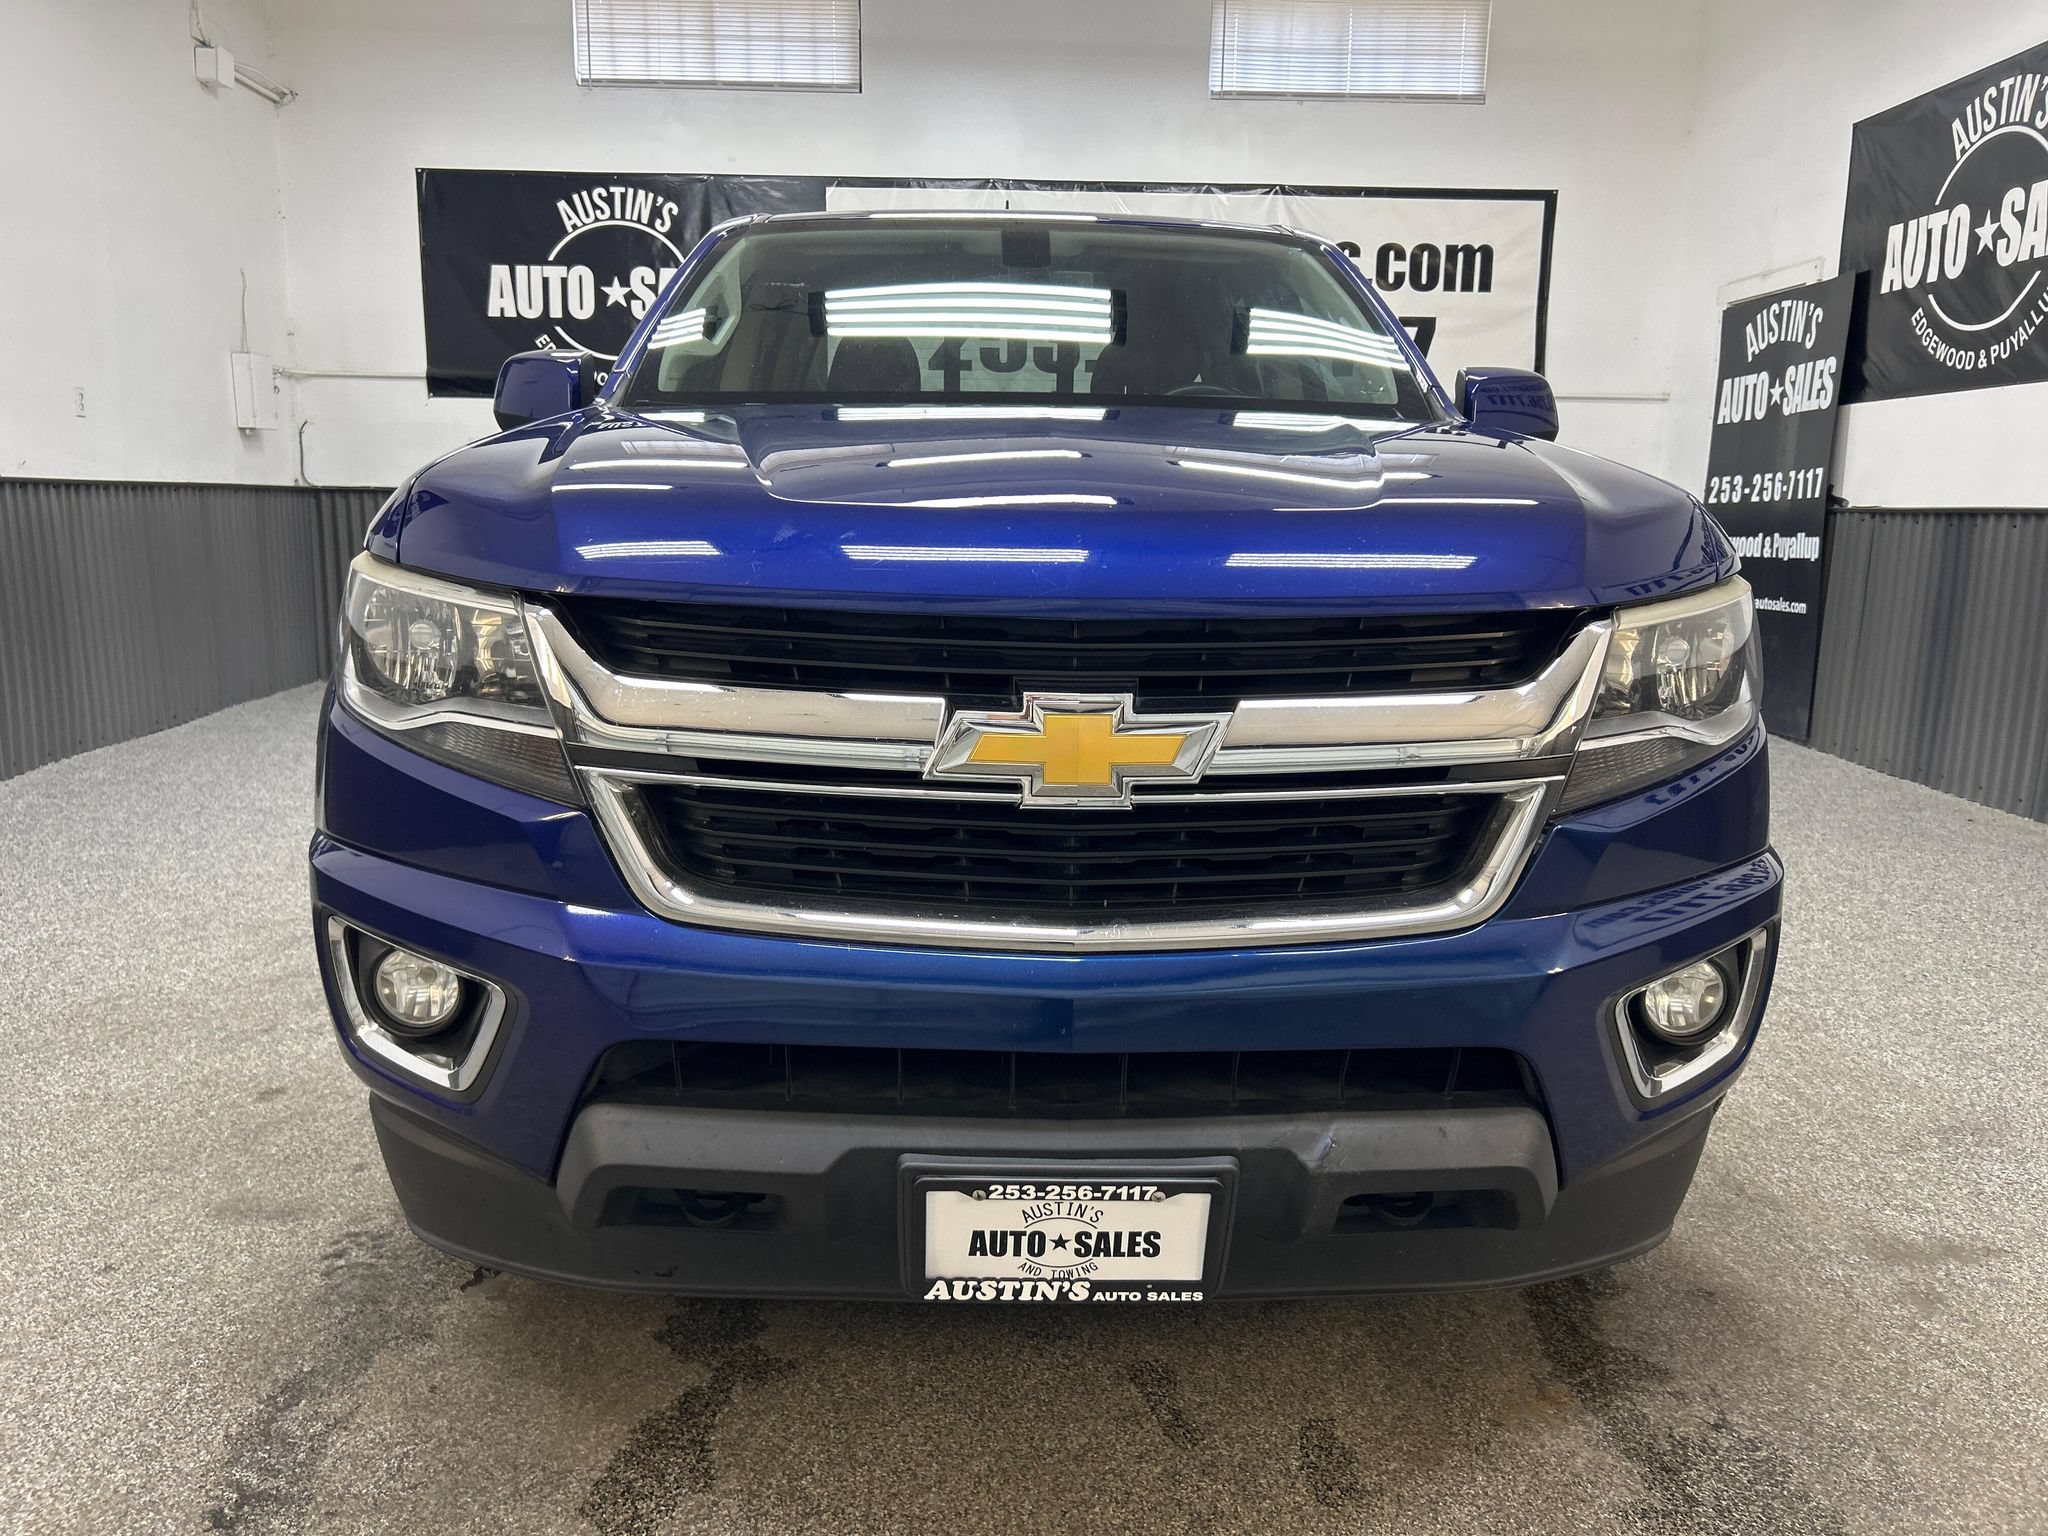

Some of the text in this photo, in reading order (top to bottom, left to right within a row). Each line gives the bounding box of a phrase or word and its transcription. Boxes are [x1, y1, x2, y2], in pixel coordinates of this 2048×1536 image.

[556, 186, 679, 235] AUSTIN'S
[1880, 179, 2048, 294] AUTO SA
[487, 264, 595, 320] AUTO
[1745, 300, 1824, 363] AUSTIN'S
[1911, 286, 2048, 370] EDGEWOOD & PUYALLU
[1716, 356, 1837, 425] AUTO SALES
[1708, 467, 1824, 504] 253-256-7117
[1729, 532, 1820, 561] wood & Puyallup
[1754, 597, 1807, 614] autosales.com
[988, 1184, 1158, 1201] 253-256-7117
[1021, 1201, 1104, 1224] AUSTIN'S
[968, 1230, 1162, 1258] AUTO SALES
[1017, 1261, 1099, 1279] AND TOWING
[923, 1280, 1204, 1301] AUSTIN'S AUTO SALES
